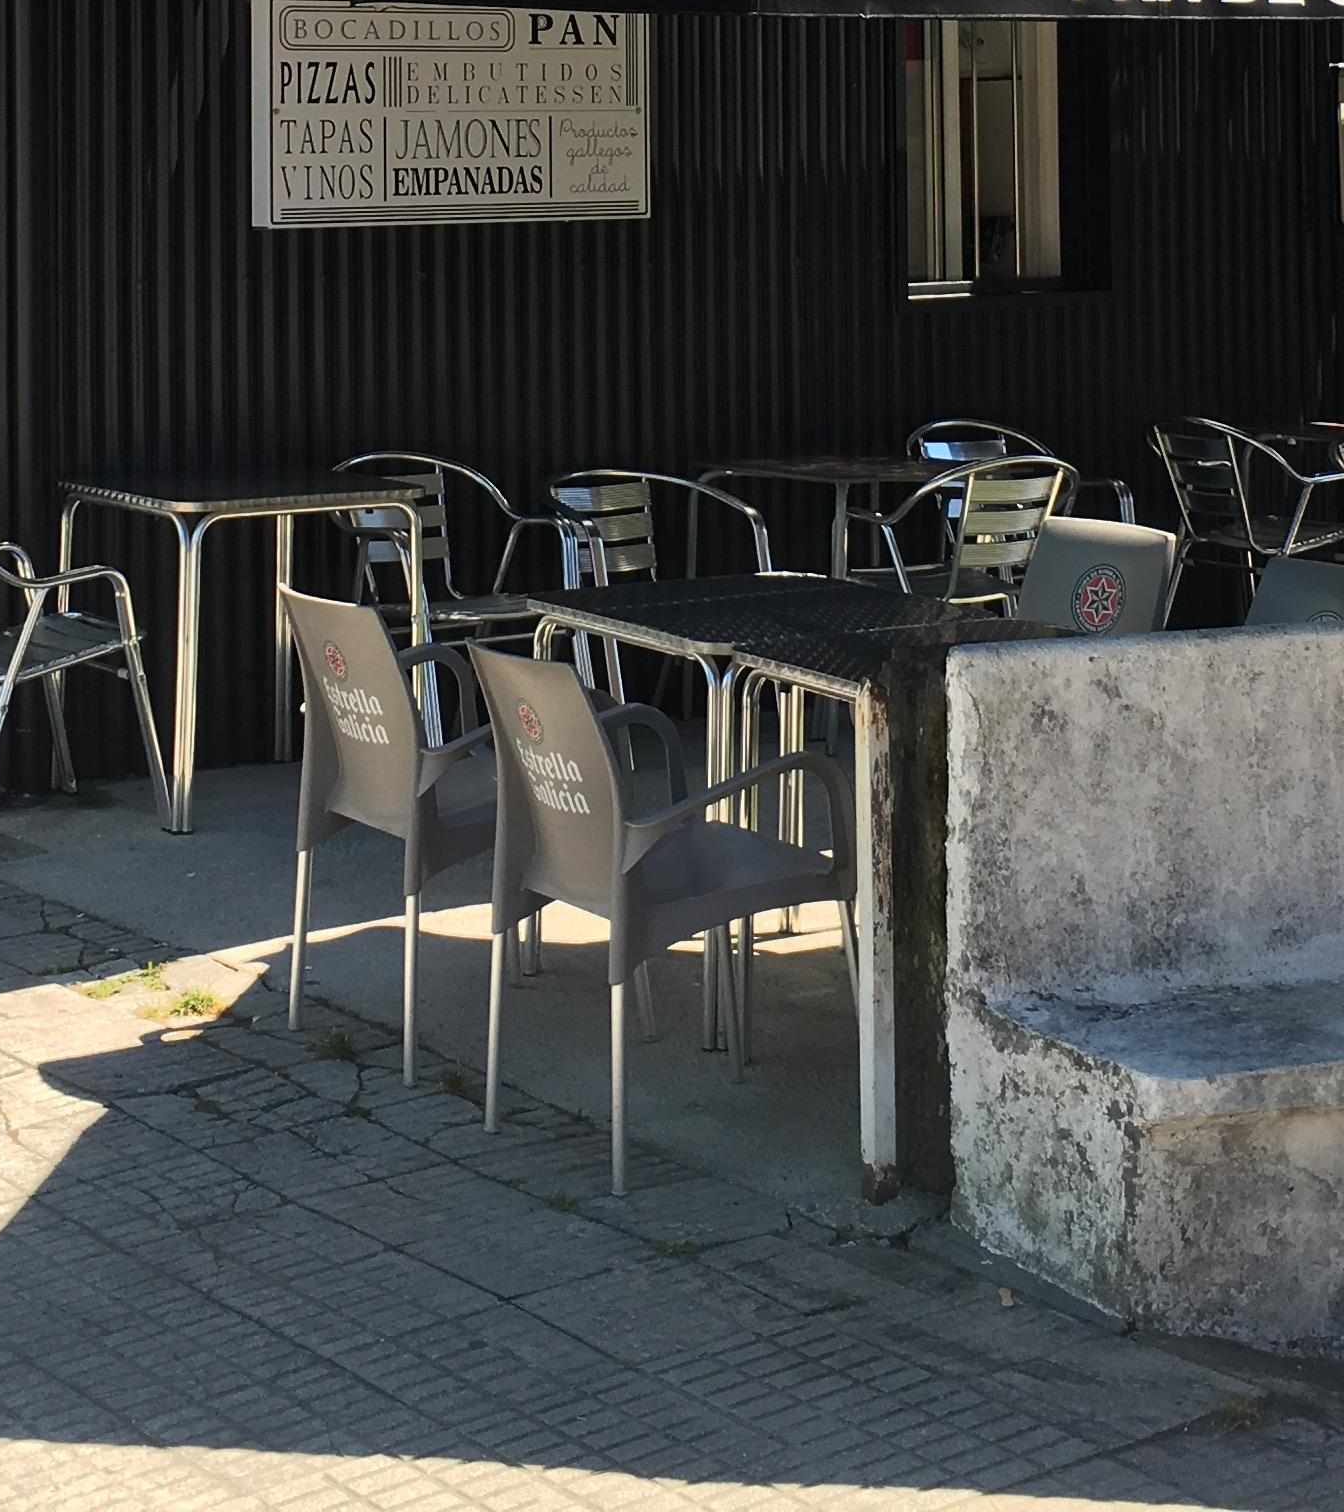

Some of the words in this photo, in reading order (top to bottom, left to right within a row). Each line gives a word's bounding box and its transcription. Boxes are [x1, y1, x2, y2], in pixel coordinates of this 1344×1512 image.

[293, 18, 501, 41] BOCADILLOS
[528, 13, 620, 46] PAN
[280, 61, 376, 105] PIZZAS
[406, 62, 623, 82] EMBUTIDOS
[406, 85, 623, 105] DELICATESSEN
[280, 118, 374, 154] TAPAS
[395, 118, 543, 160] JAMONES
[559, 118, 638, 138] Productos
[566, 137, 633, 166] gallegos
[591, 157, 609, 175] de
[280, 163, 374, 201] VINOS
[392, 164, 544, 197] EMPANADAS
[568, 174, 631, 193] calidad
[322, 675, 384, 716] Estrella
[516, 737, 583, 782] Estrella
